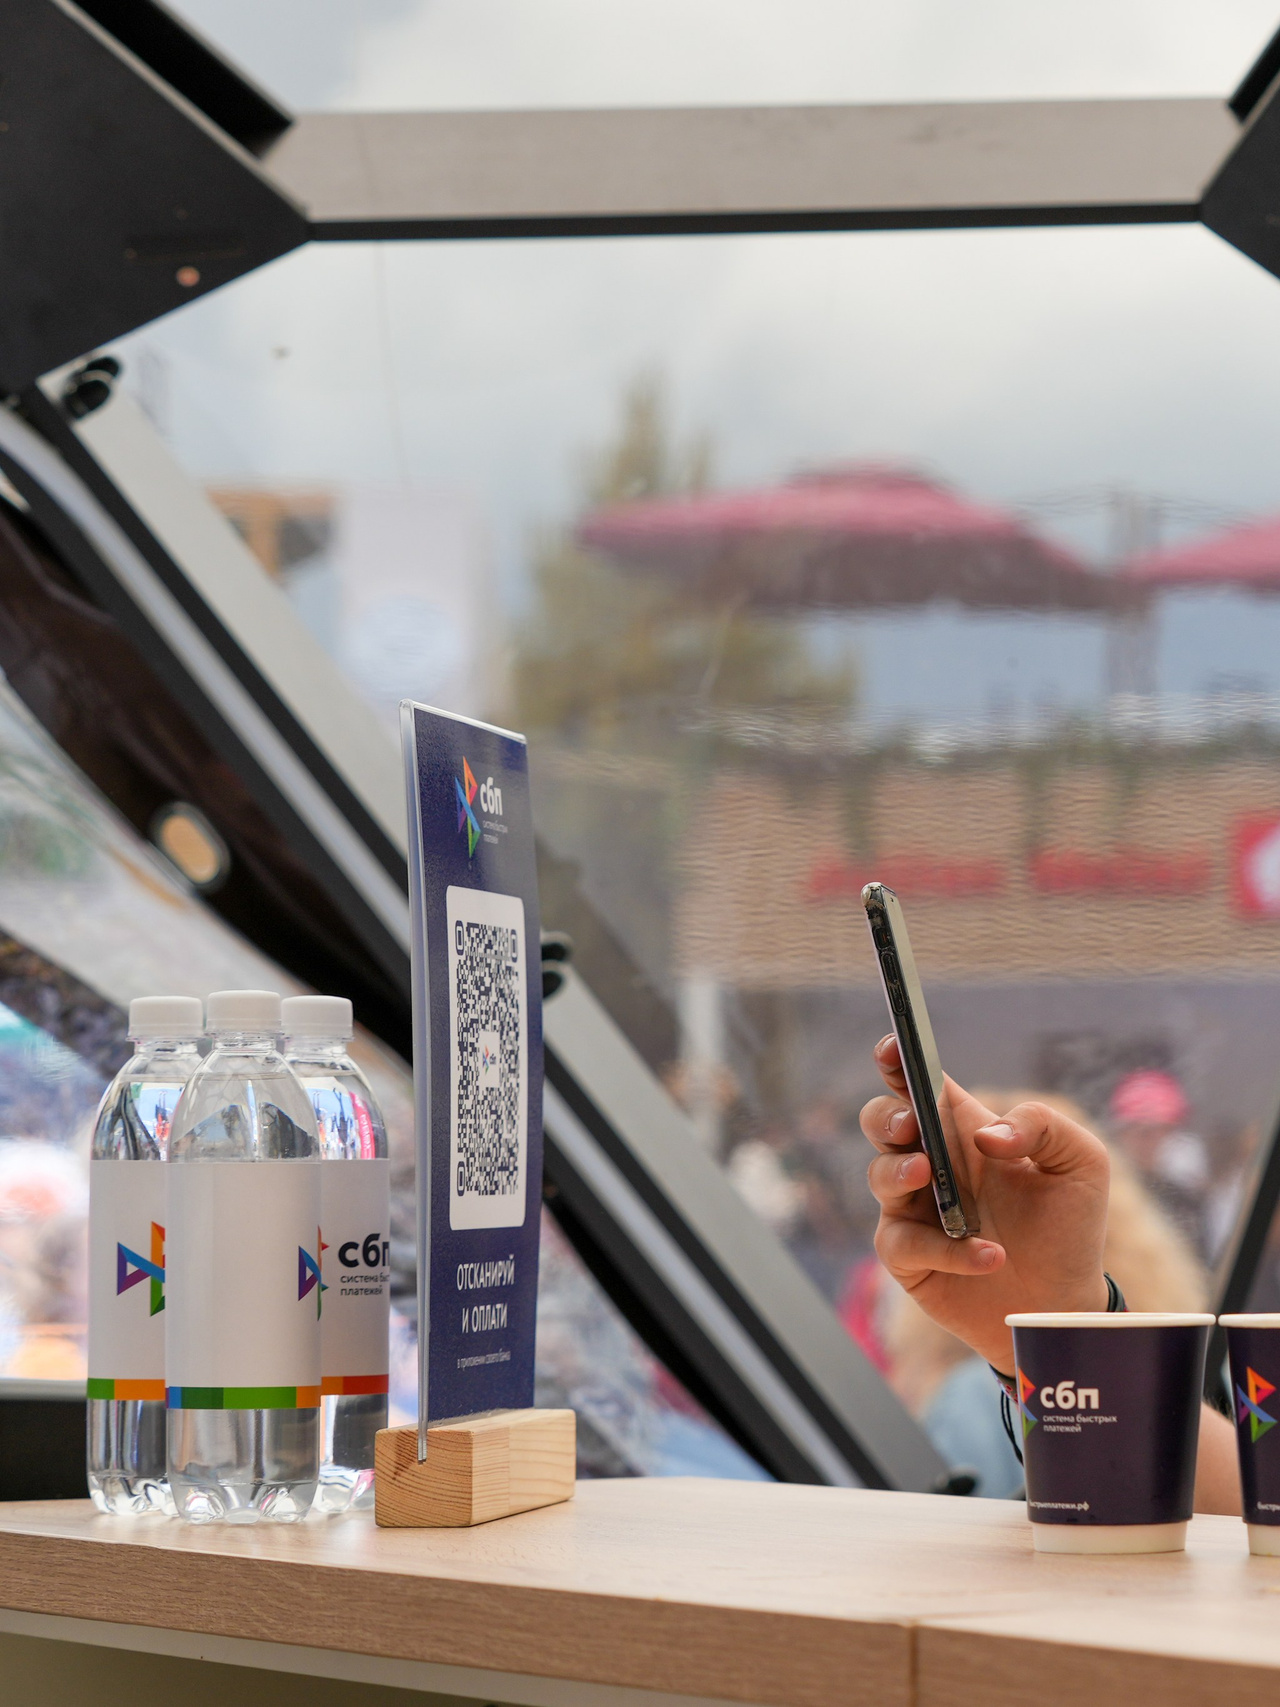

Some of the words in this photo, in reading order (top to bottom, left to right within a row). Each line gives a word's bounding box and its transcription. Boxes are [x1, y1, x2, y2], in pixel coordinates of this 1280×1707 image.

[480, 776, 503, 816] сбп
[340, 1275, 378, 1284] система
[457, 1253, 515, 1290] ОТСКАНИРУЙ
[340, 1285, 383, 1296] платежей
[462, 1307, 469, 1333] И
[471, 1303, 508, 1332] ОПЛАТИ
[1040, 1381, 1100, 1411] сбп
[1043, 1415, 1075, 1423] система
[1076, 1414, 1118, 1425] быстрых
[1043, 1424, 1082, 1433] платежей
